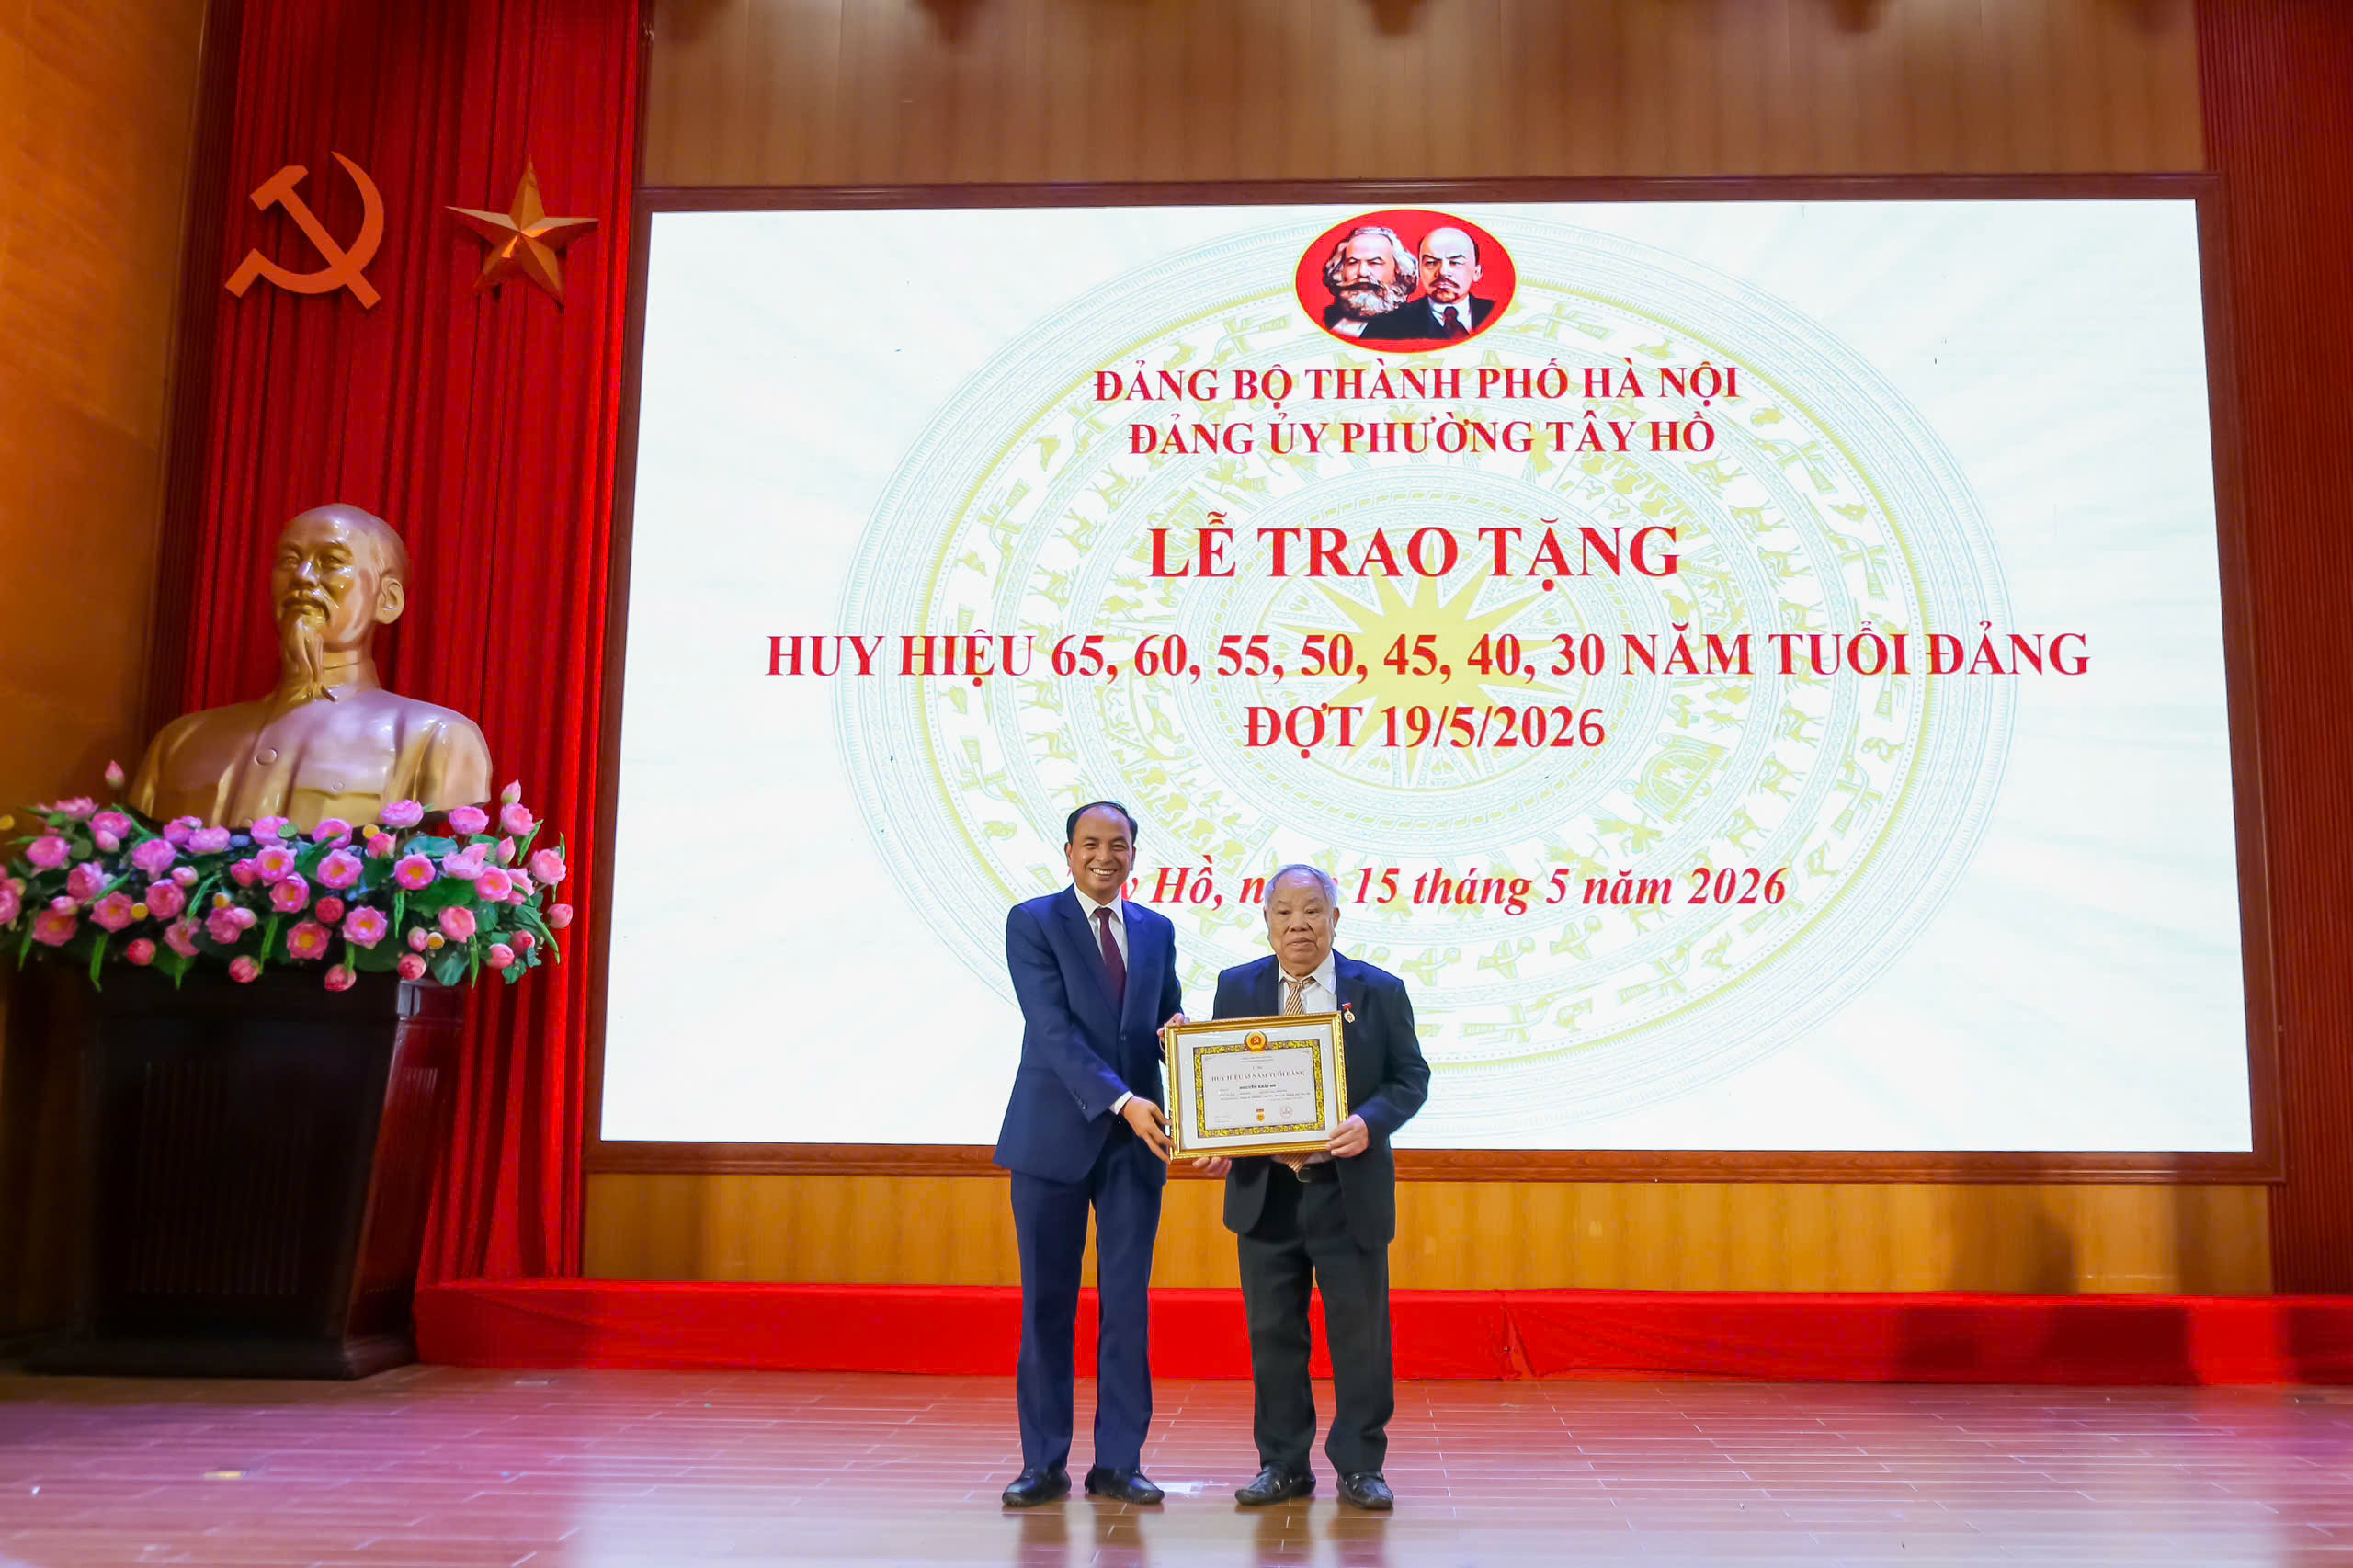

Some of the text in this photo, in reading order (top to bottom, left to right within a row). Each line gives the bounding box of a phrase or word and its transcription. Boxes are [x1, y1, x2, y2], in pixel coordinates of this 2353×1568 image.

[1093, 357, 1740, 411] ĐẢNG BỘ THÀNH PHỐ HÀ NỘI
[1128, 410, 1716, 455] ĐẢNG ỦY PHƯỜNG TÂY HỒ
[1149, 510, 1680, 593] LỄ TRAO TẶNG
[765, 619, 2090, 687] HUY HIỆU 65, 60, 55, 50, 45, 40, 30 NĂM TUỔI ĐẢNG
[1244, 702, 1606, 760] ĐỢT 19/5/2026
[1149, 854, 1223, 911] Hồ,
[1354, 867, 1401, 904] 15
[1413, 864, 1533, 916] tháng
[1546, 867, 1570, 905] 5
[1582, 863, 1673, 905] năm
[1687, 867, 1788, 905] 2026
